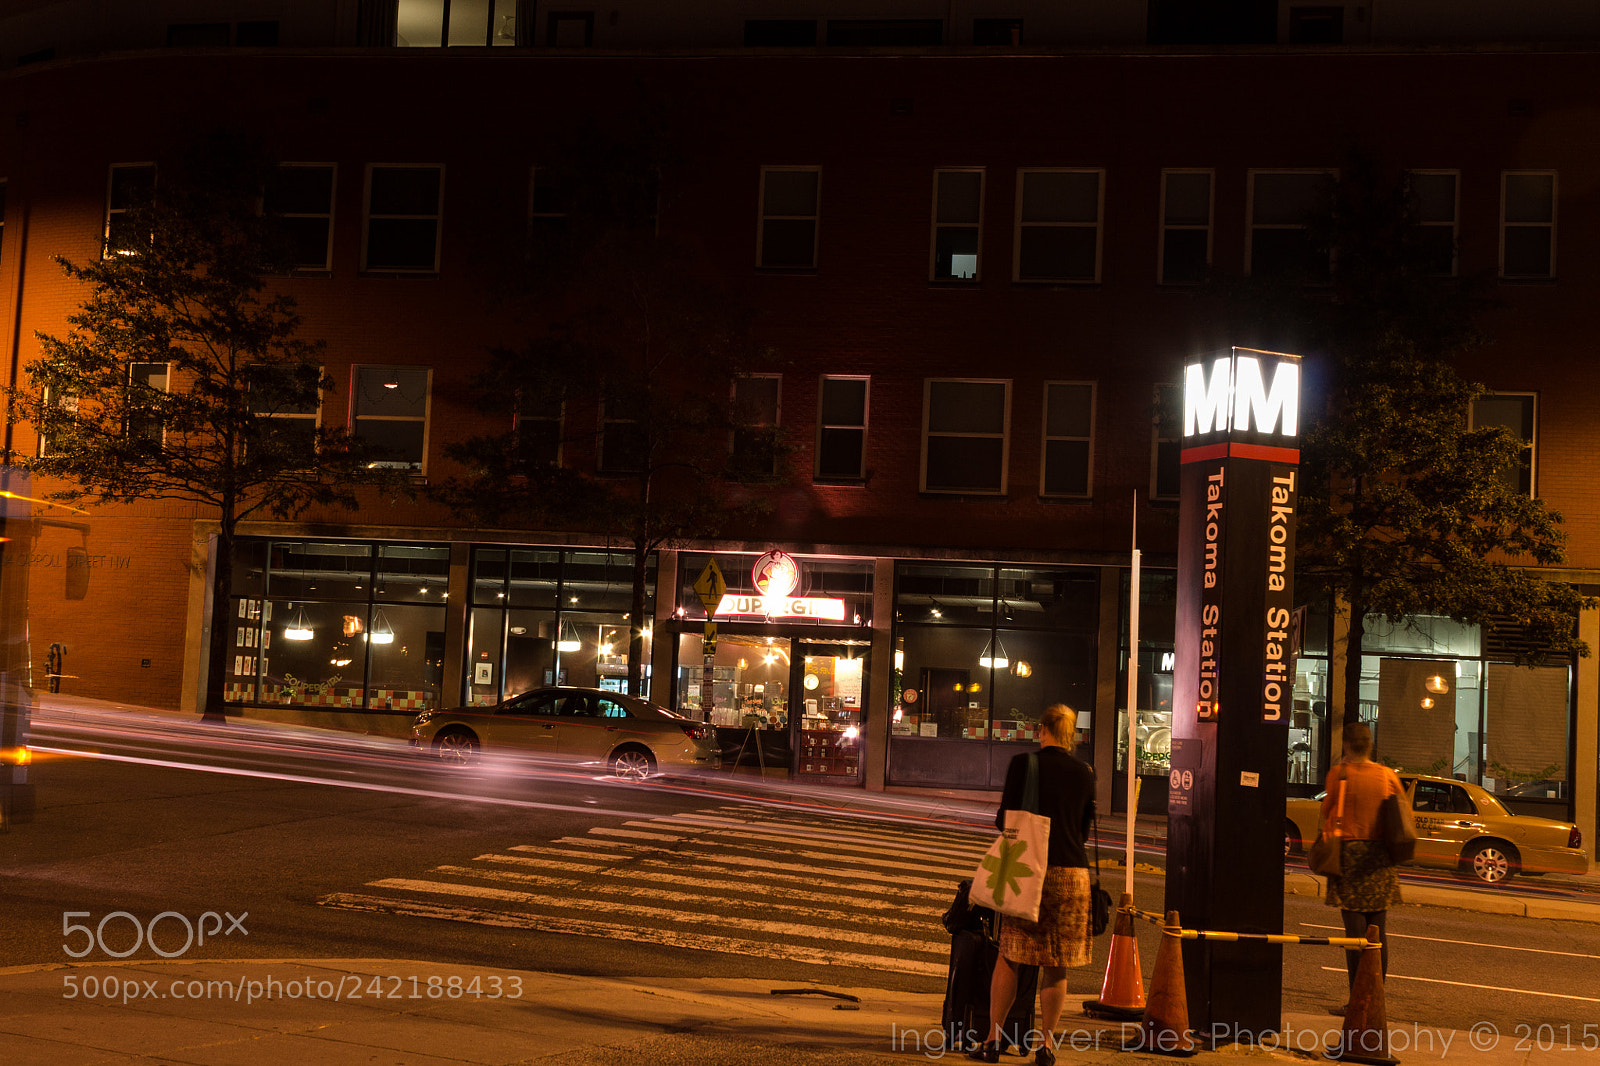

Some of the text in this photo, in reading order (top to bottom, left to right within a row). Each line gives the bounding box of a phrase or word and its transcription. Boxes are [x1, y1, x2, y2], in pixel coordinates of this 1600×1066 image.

[1184, 357, 1231, 437] M
[1234, 356, 1299, 437] M
[1199, 467, 1225, 718] Takoma Station
[1264, 472, 1295, 721] Takoma Station
